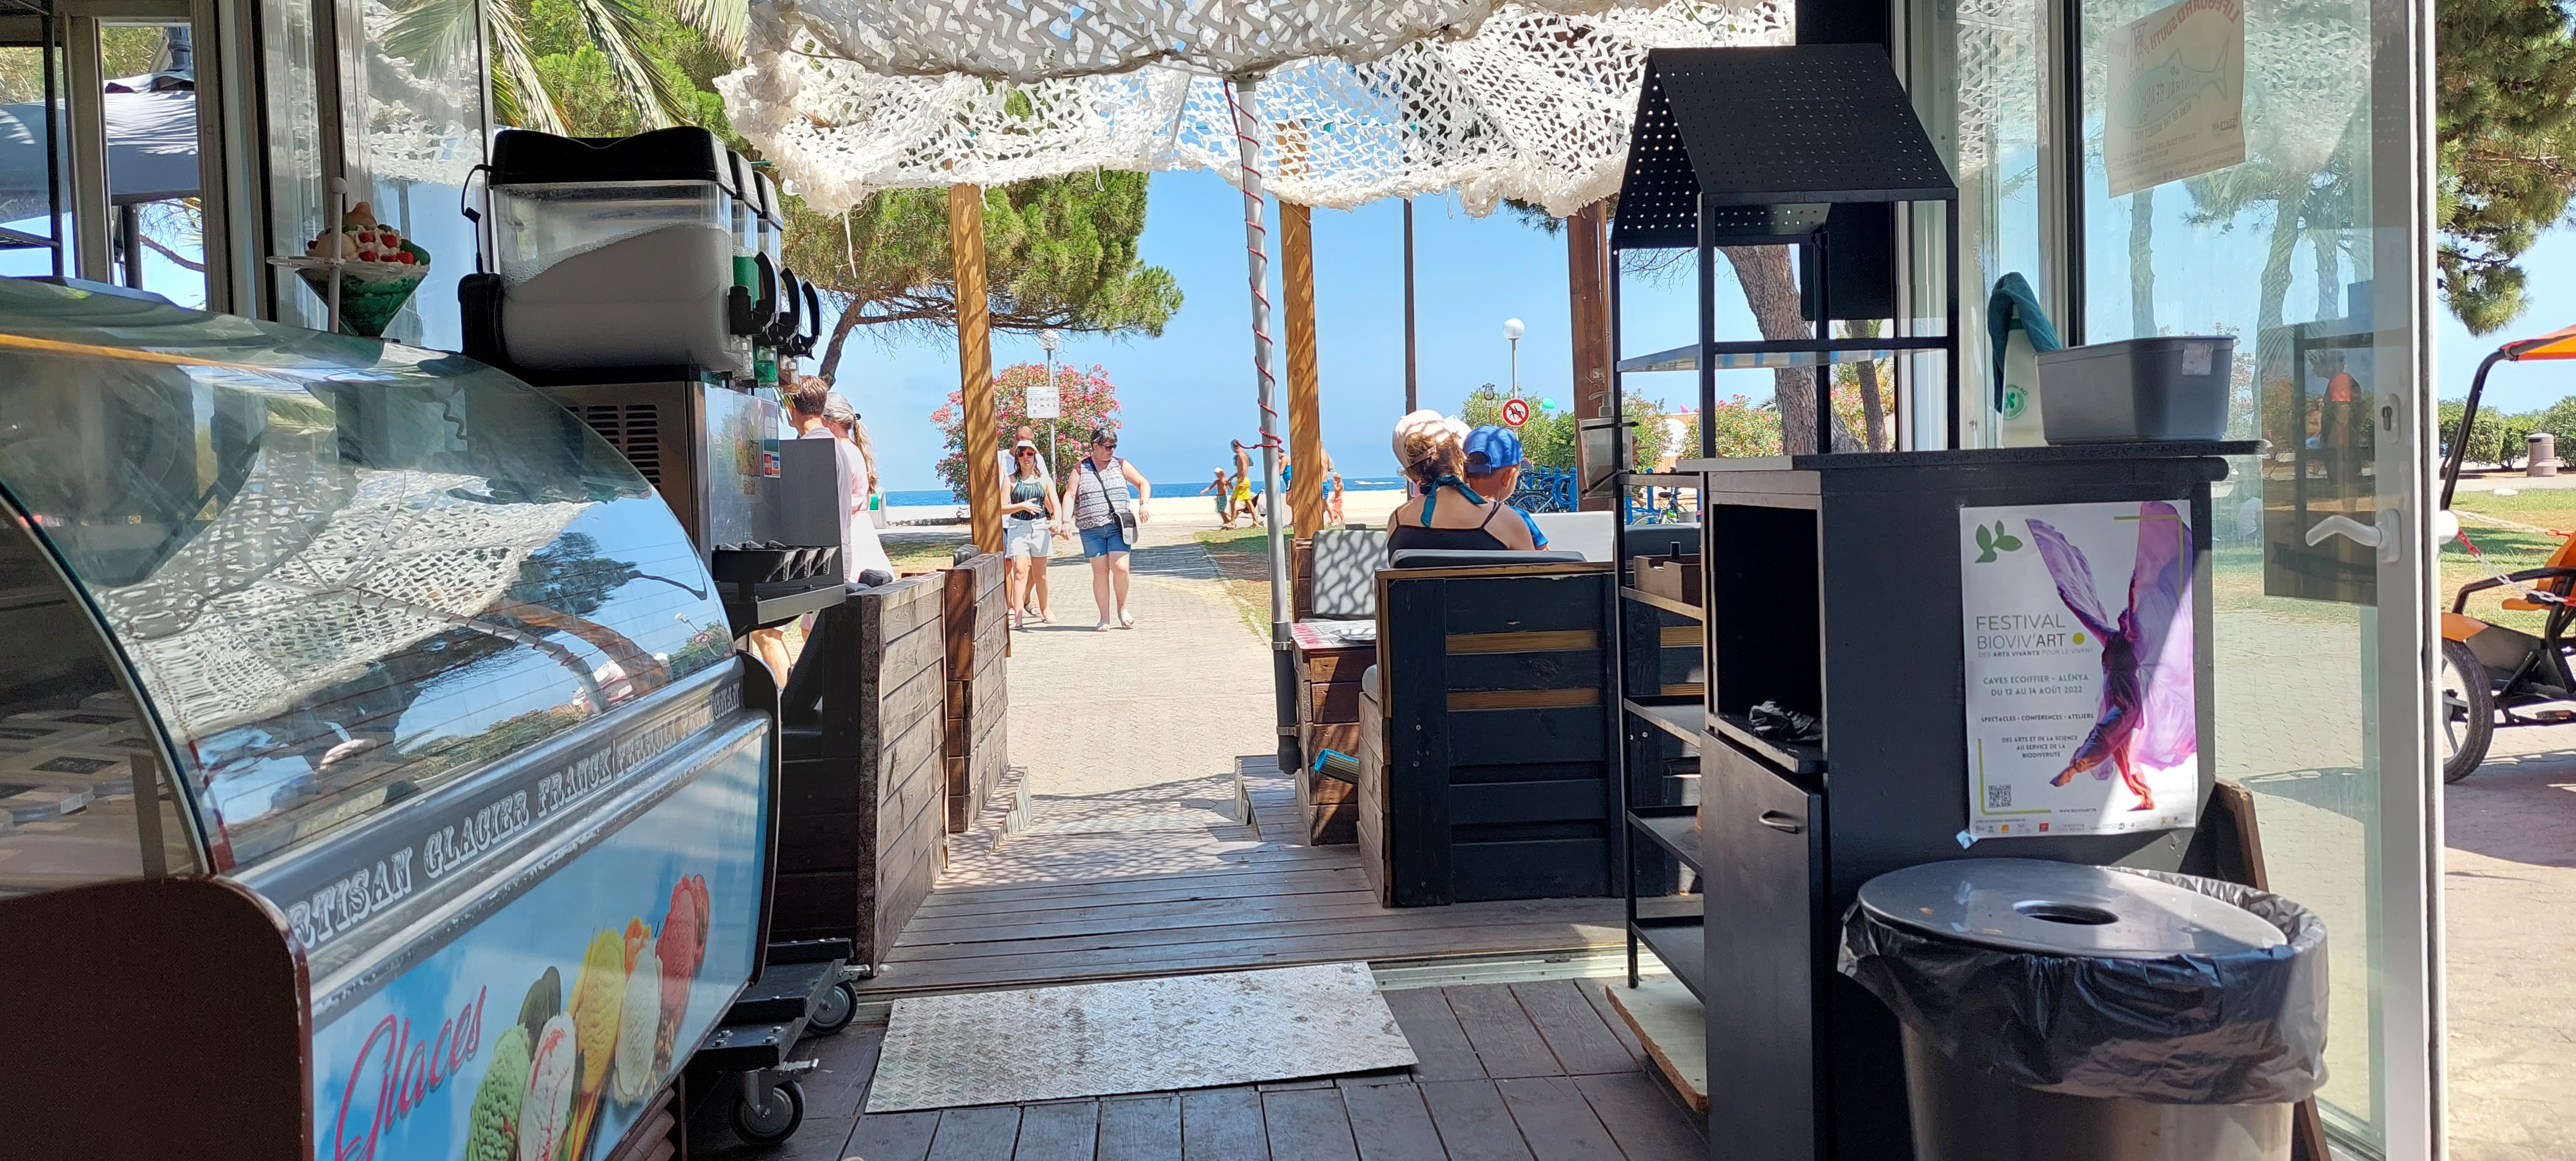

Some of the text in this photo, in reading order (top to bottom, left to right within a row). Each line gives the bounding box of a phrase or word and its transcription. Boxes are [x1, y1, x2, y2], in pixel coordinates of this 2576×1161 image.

[1976, 613, 2066, 631] FESTIVAL
[1978, 633, 2066, 650] BIOVIV'ART
[1983, 676, 2008, 685] CAVES
[2011, 675, 2049, 684] ECOIFFIER
[2039, 685, 2061, 694] AOÛT
[286, 846, 413, 949] RTISAN
[423, 789, 530, 879] GLACIER
[537, 747, 613, 817] FRANCK
[335, 984, 487, 1161] Glaces
